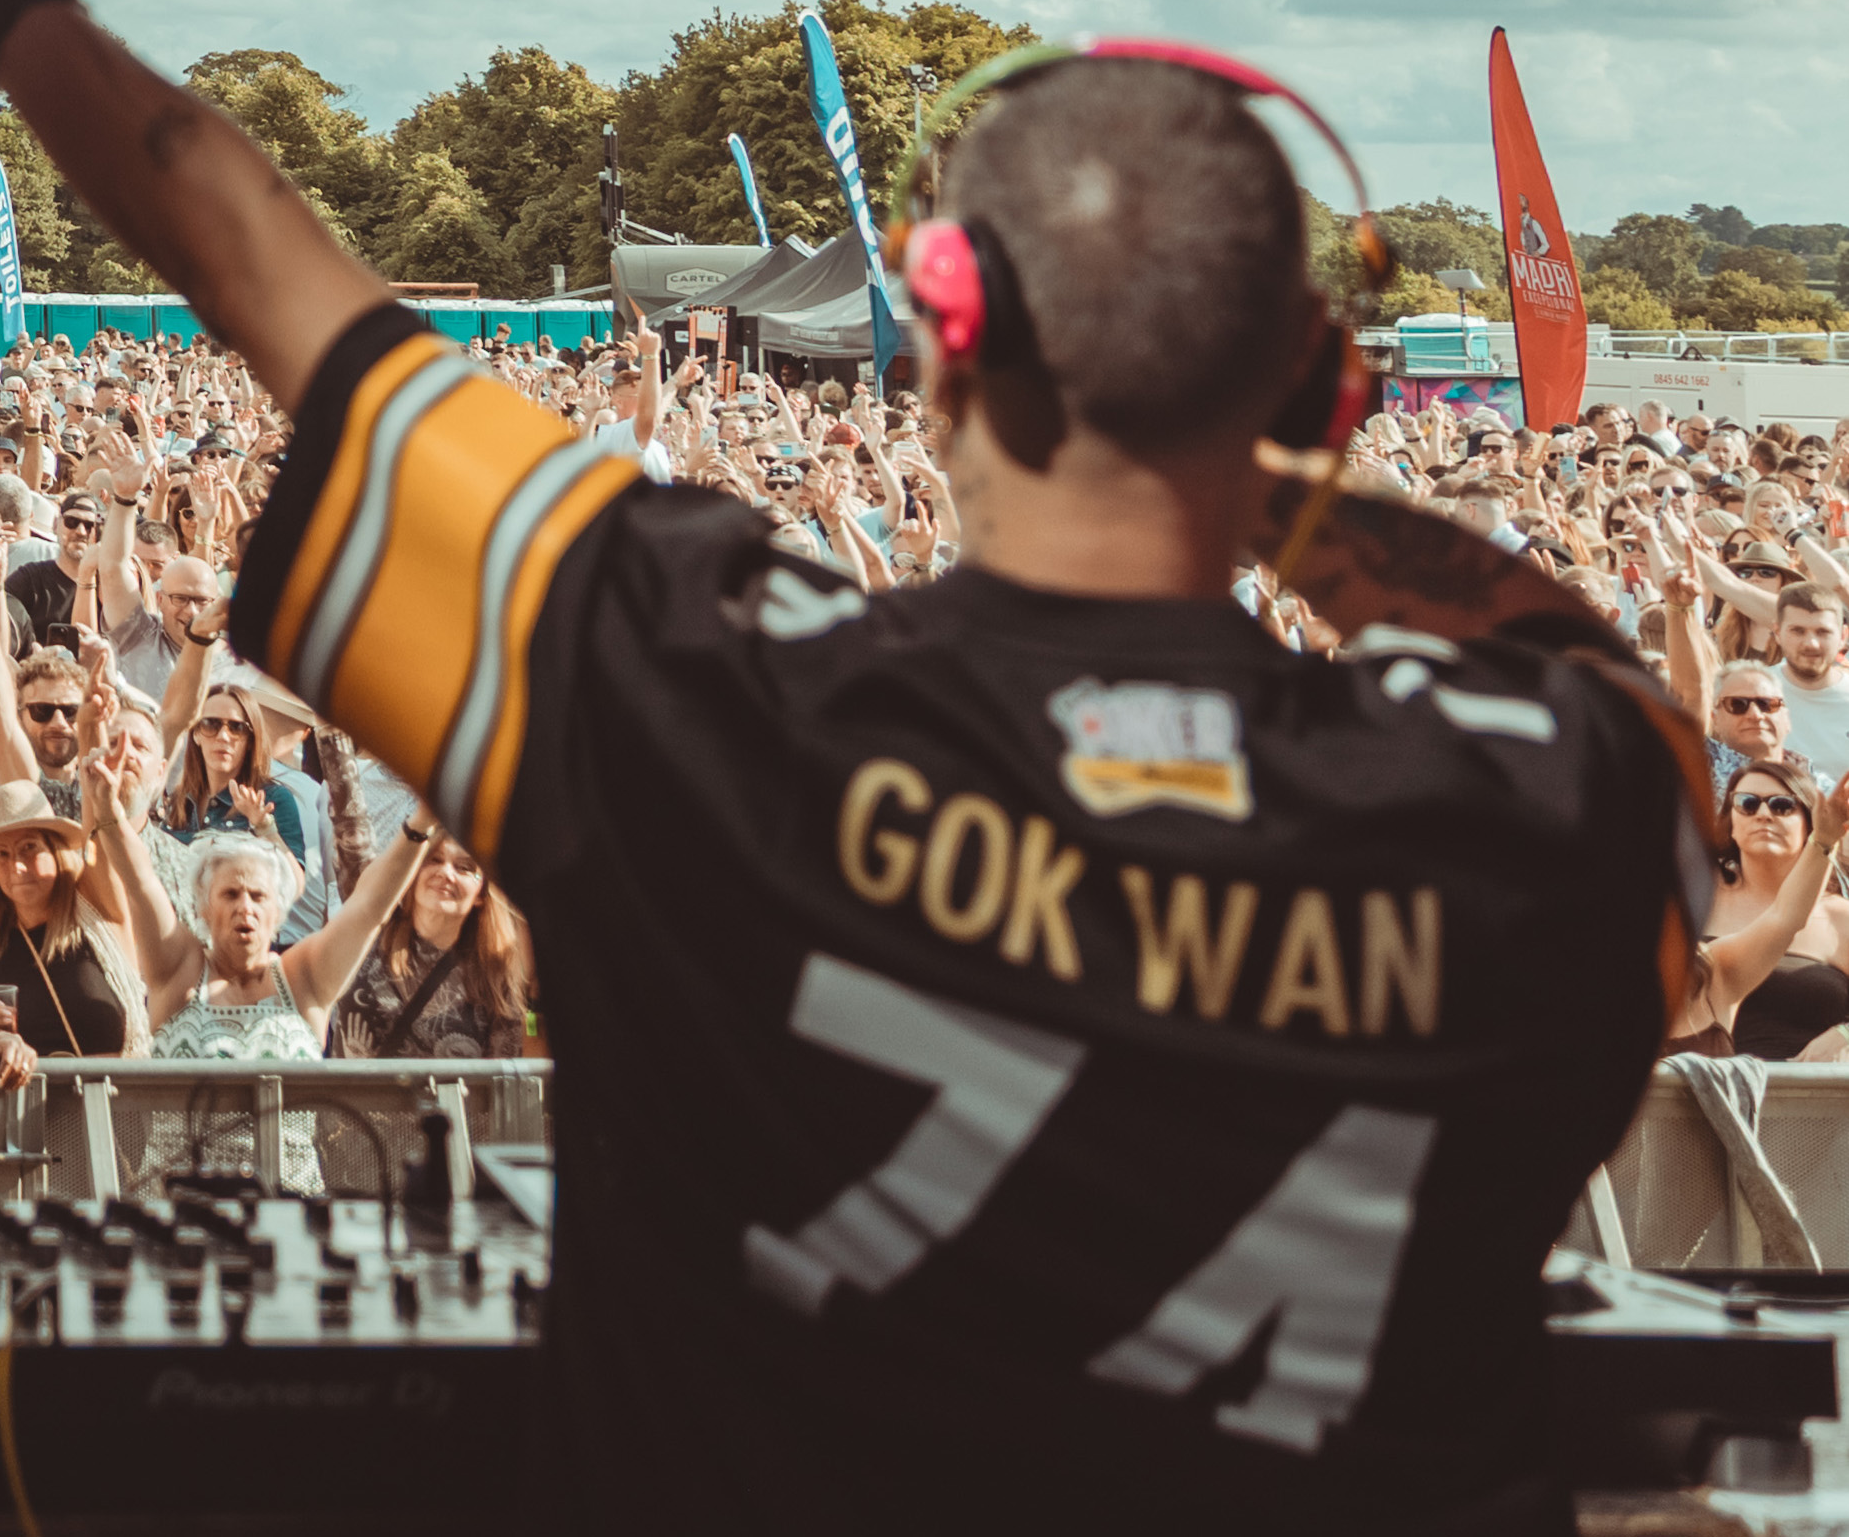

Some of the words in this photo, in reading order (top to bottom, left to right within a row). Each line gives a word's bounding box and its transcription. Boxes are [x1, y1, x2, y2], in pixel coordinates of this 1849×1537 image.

[670, 275, 722, 283] CARTEL
[836, 755, 1084, 981] GOK
[1121, 865, 1443, 1039] WAN
